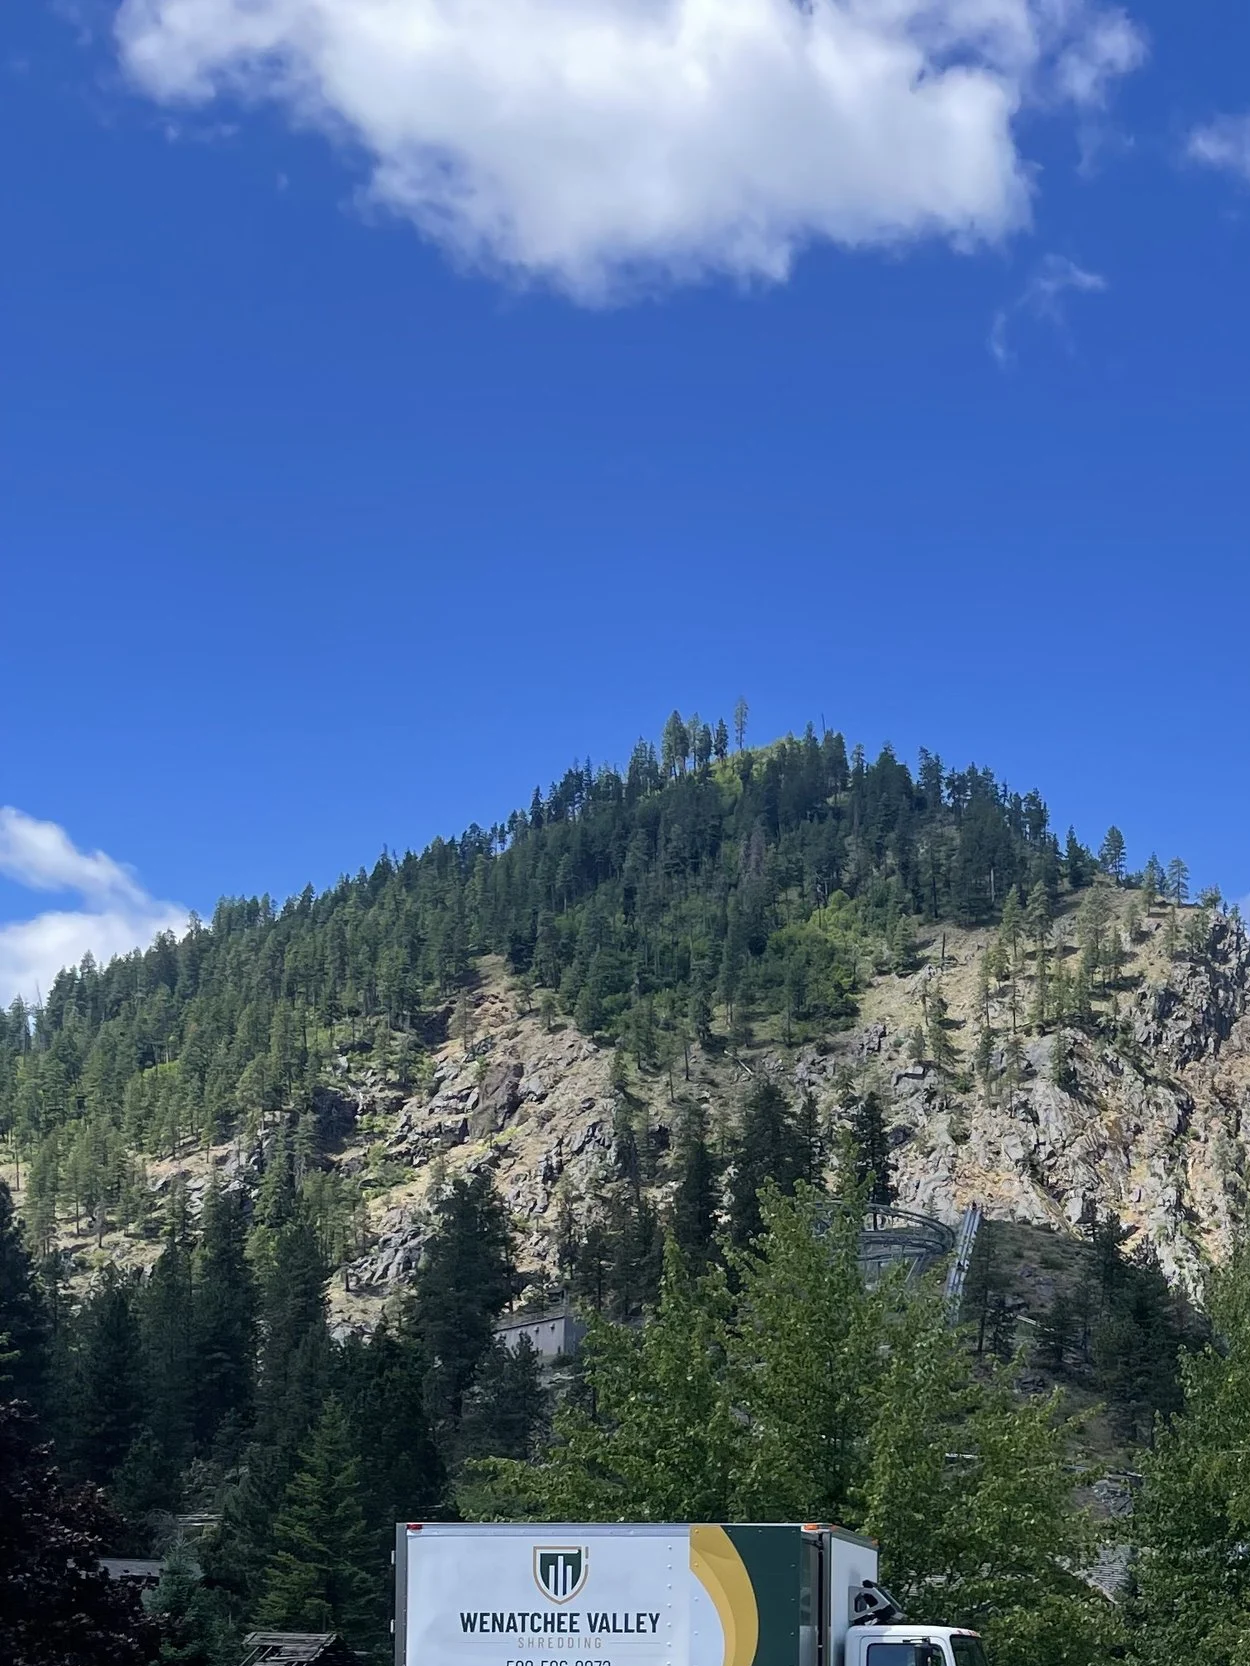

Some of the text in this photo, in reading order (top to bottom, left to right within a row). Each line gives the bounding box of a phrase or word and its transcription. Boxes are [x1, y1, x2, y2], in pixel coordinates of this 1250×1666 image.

[460, 1612, 661, 1634] WENATCHEE VALLEY
[517, 1637, 603, 1649] SHREDDING
